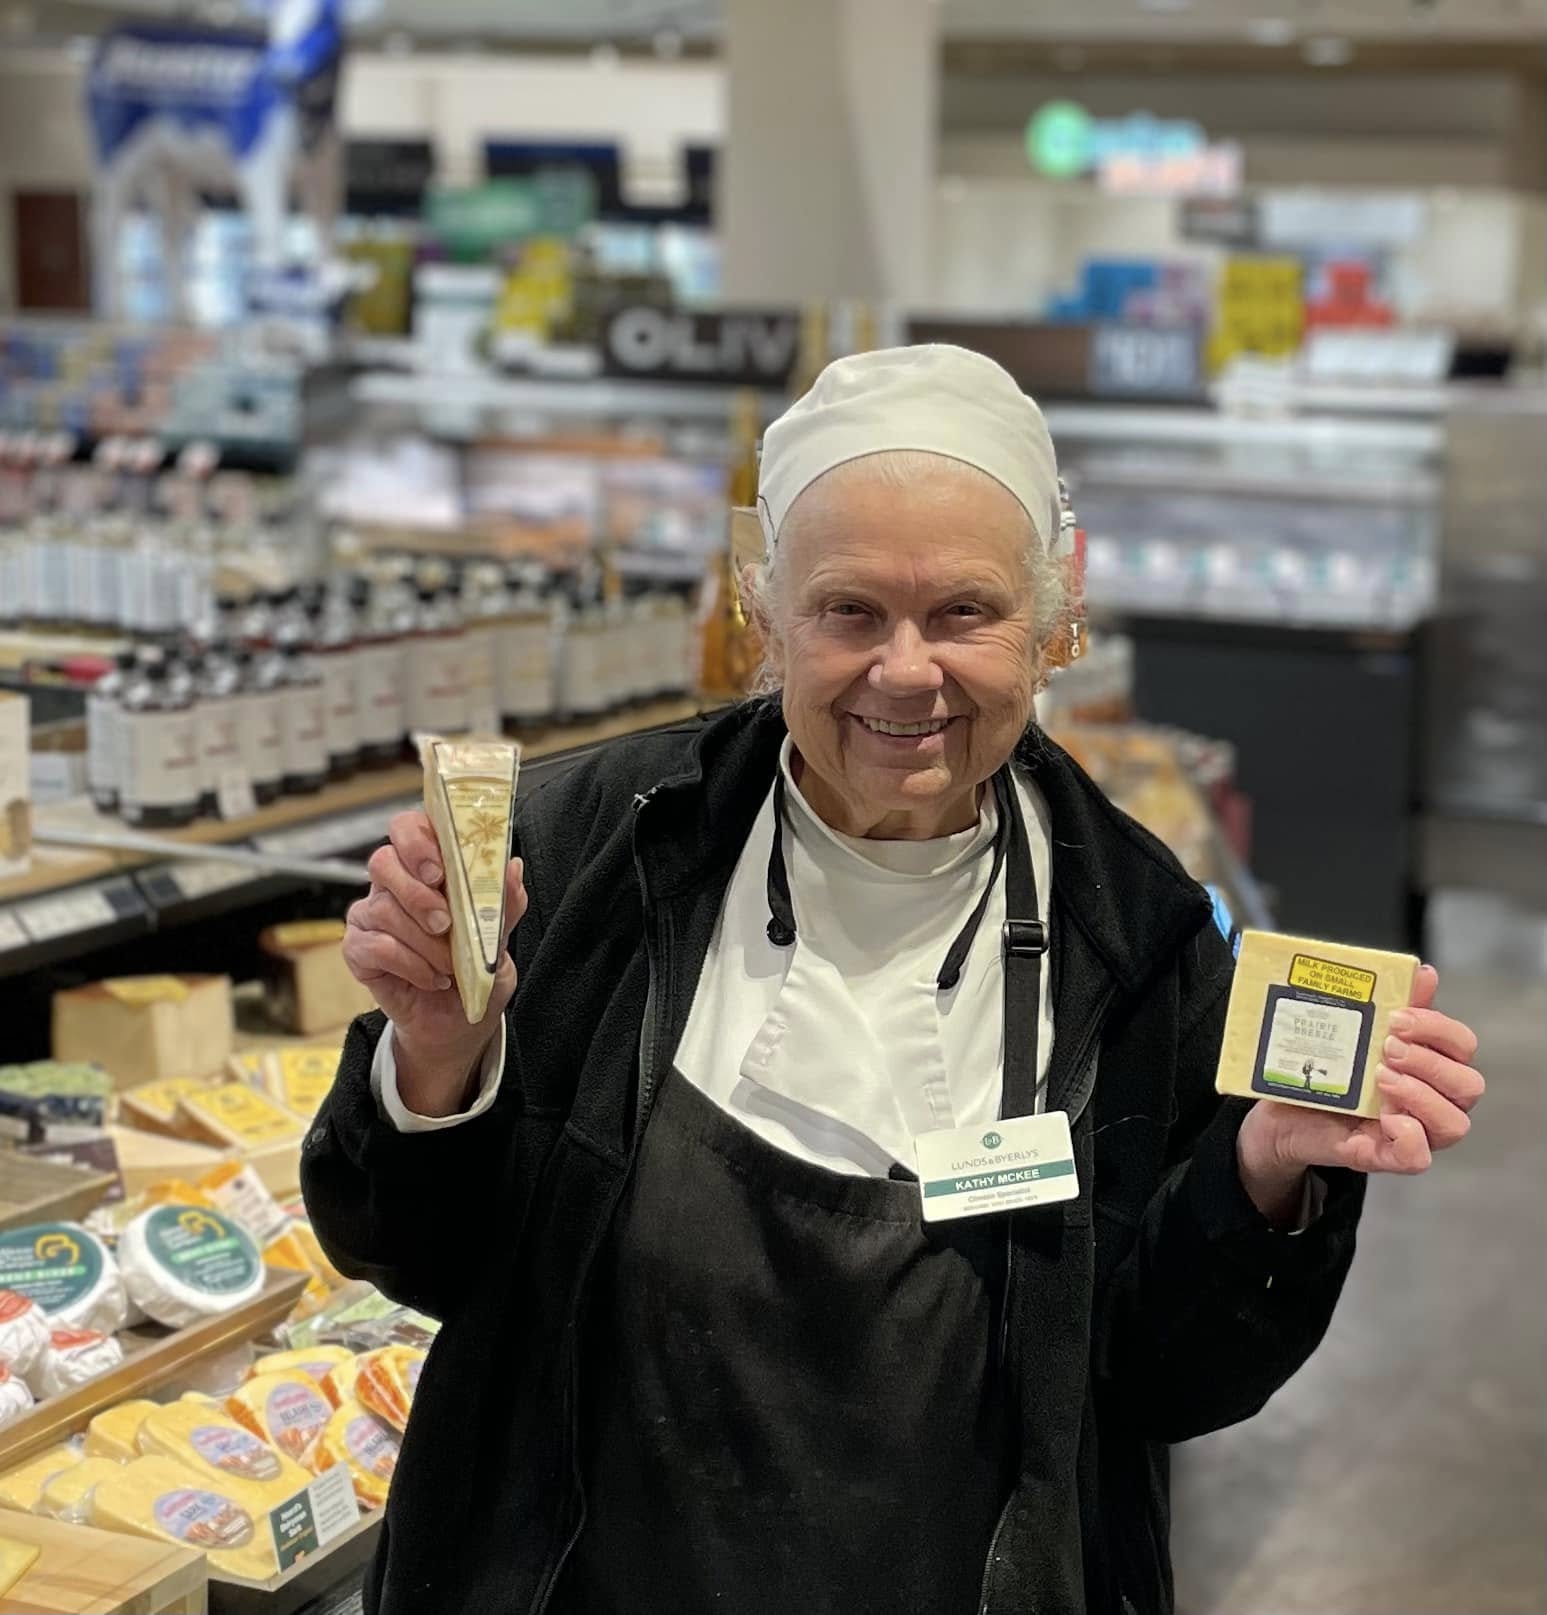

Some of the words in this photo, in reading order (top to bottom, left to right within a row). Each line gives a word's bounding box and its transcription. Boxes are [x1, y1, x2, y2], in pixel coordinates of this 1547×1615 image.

[1297, 957, 1319, 970] MILK
[1320, 963, 1372, 983] PRODUCED
[1309, 970, 1323, 980] ON
[1325, 973, 1354, 988] SMALL
[1297, 976, 1330, 991] FAMILY
[1331, 985, 1362, 999] FARMS
[955, 1175, 995, 1191] KATHY
[997, 1168, 1041, 1185] MCKEE
